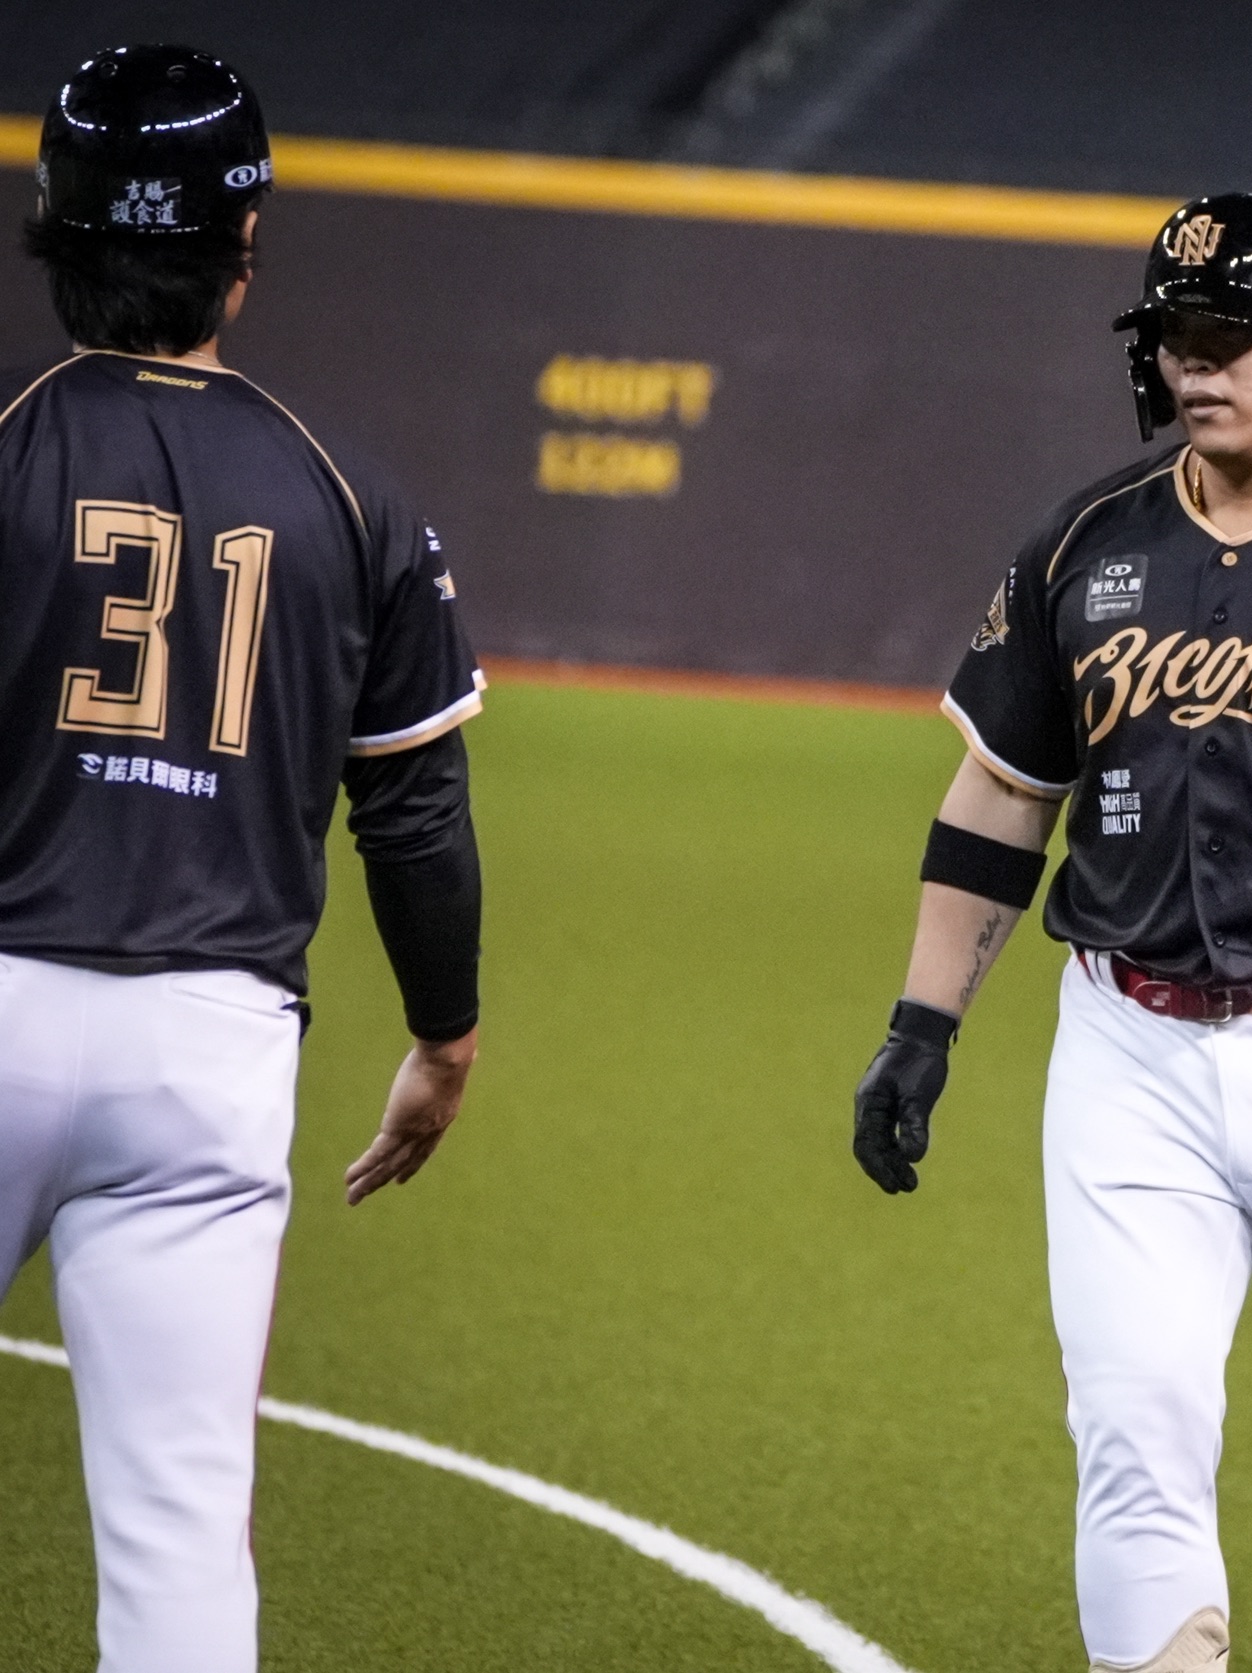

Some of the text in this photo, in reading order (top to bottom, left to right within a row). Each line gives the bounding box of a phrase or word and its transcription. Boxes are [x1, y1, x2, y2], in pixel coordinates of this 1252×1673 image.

[56, 499, 274, 758] 31
[103, 755, 218, 799] 諾貝爾眼科
[1102, 813, 1141, 835] QUALITY
